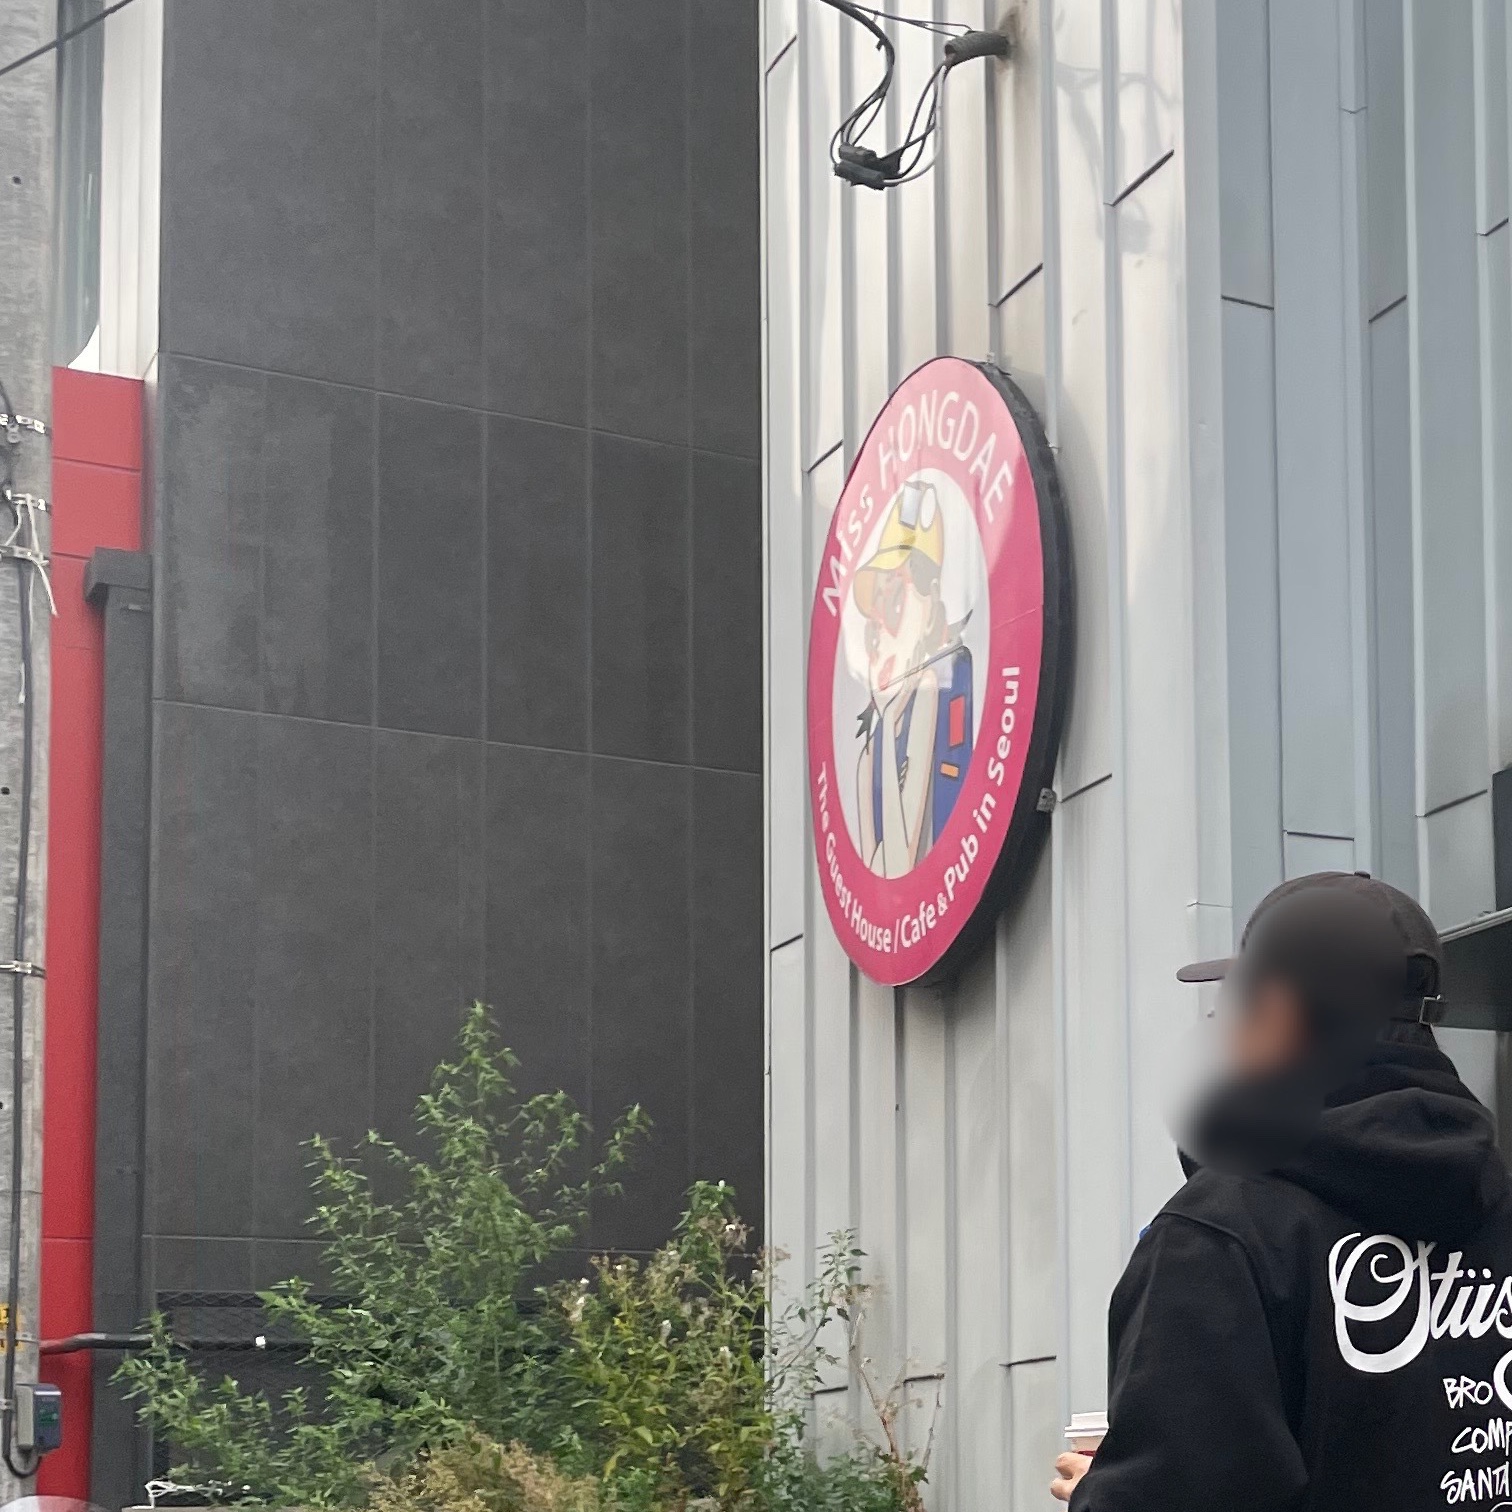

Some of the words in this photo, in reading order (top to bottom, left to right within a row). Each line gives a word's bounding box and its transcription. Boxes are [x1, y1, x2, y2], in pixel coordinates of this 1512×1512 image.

[878, 389, 1015, 523] HONGDAE
[817, 761, 829, 832] The
[826, 833, 851, 919] Guest
[943, 834, 979, 901] Pub
[973, 793, 997, 833] in
[988, 666, 1021, 786] Seoul
[1440, 1461, 1510, 1504] SANTA
